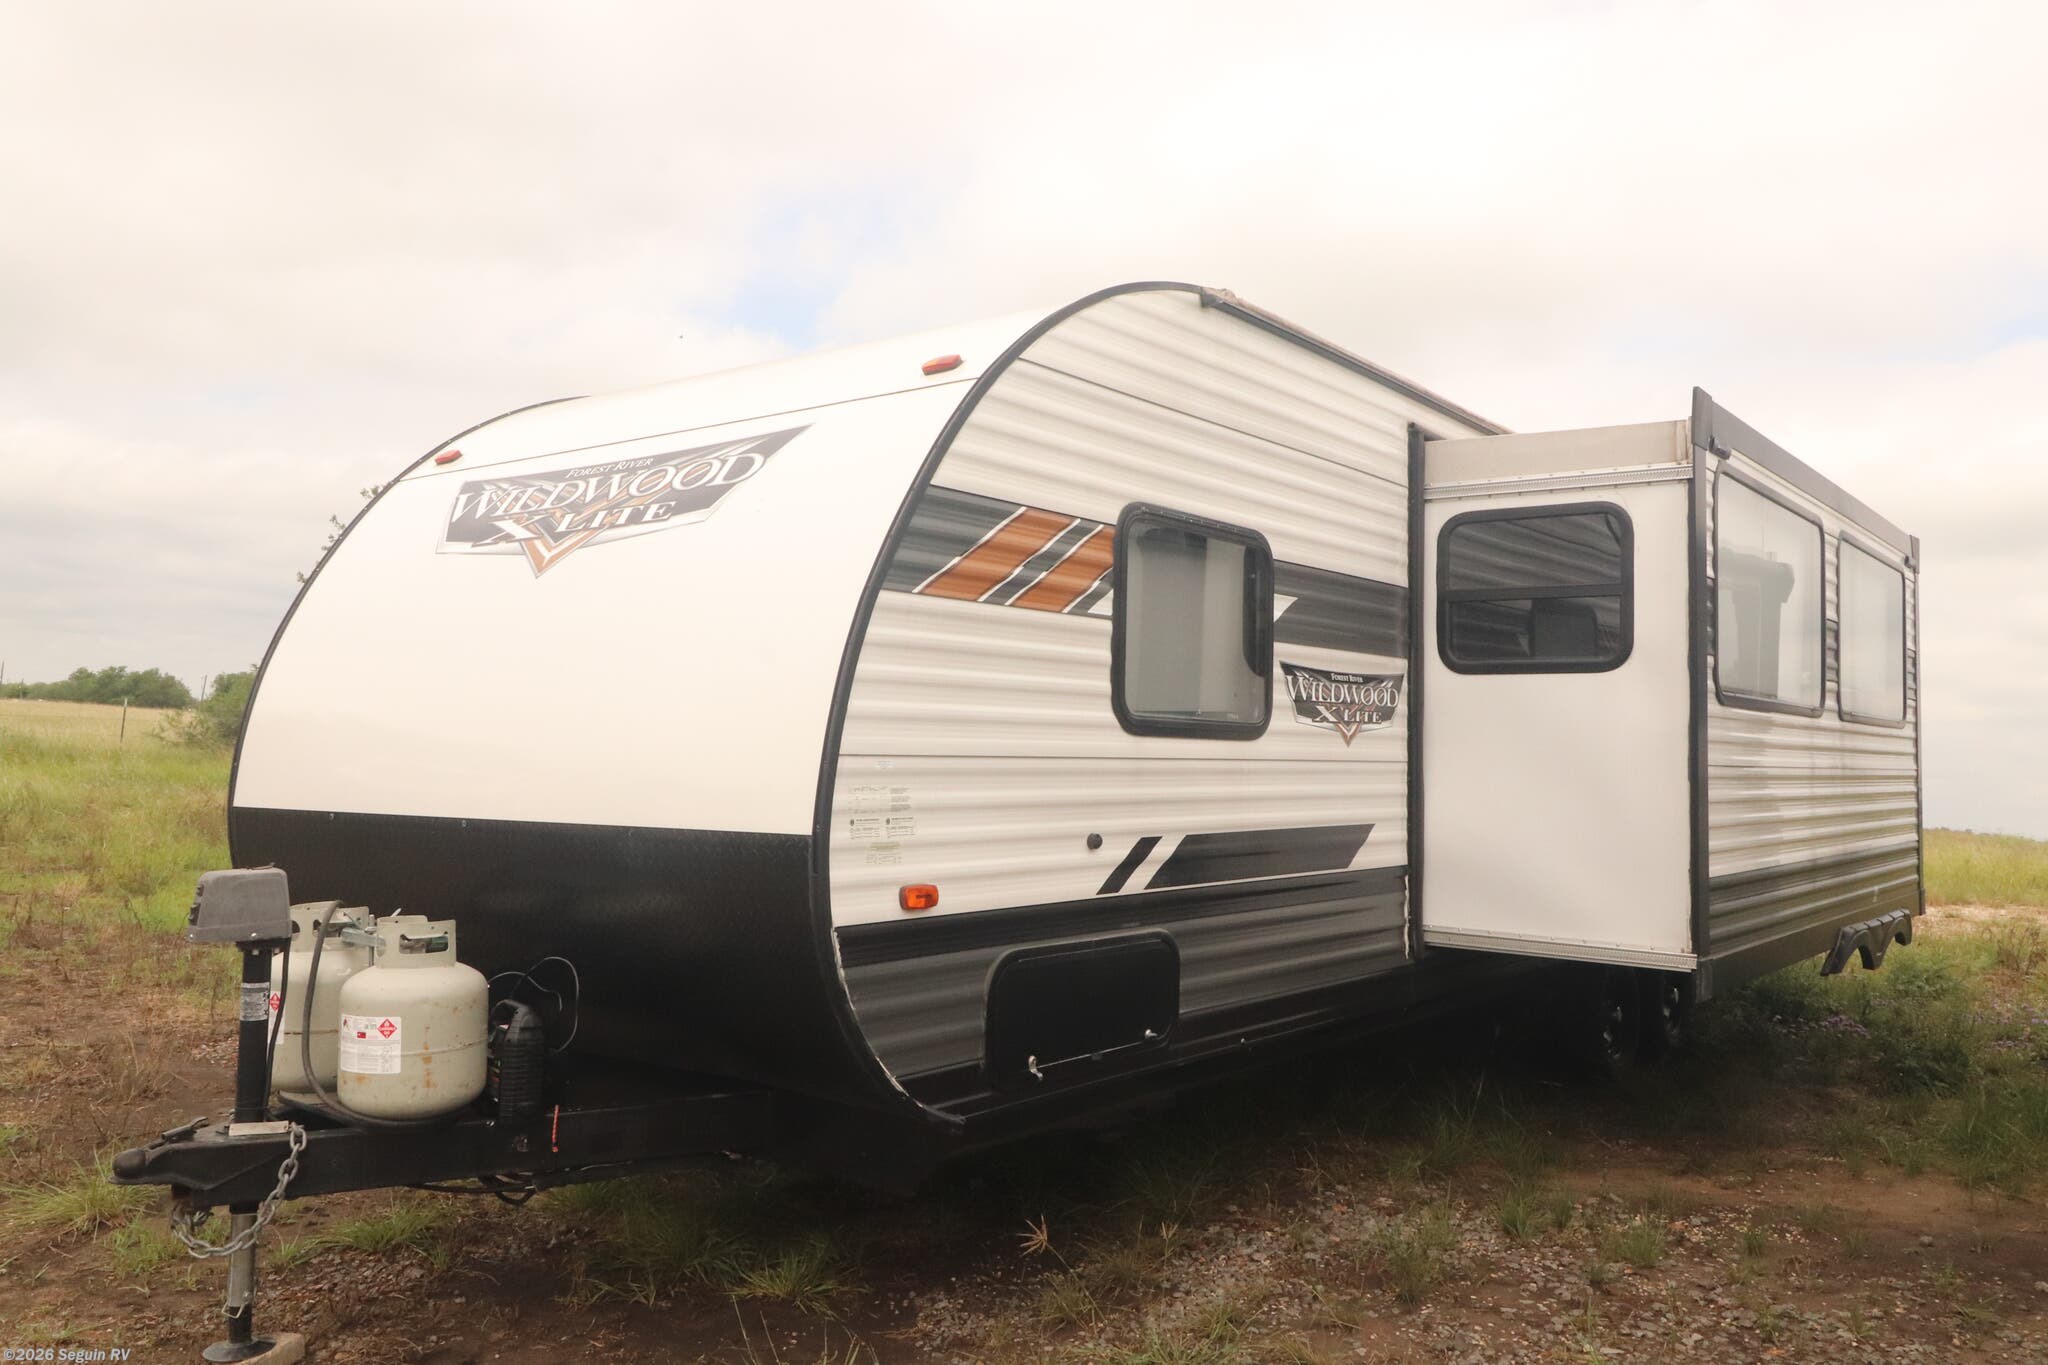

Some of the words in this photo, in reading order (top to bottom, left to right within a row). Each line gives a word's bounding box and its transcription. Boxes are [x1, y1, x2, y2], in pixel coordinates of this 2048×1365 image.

[565, 464, 615, 479] FOREST
[613, 457, 655, 471] RIVER
[452, 452, 768, 523] WILDWOOD
[1286, 675, 1399, 708] WILDWOOD
